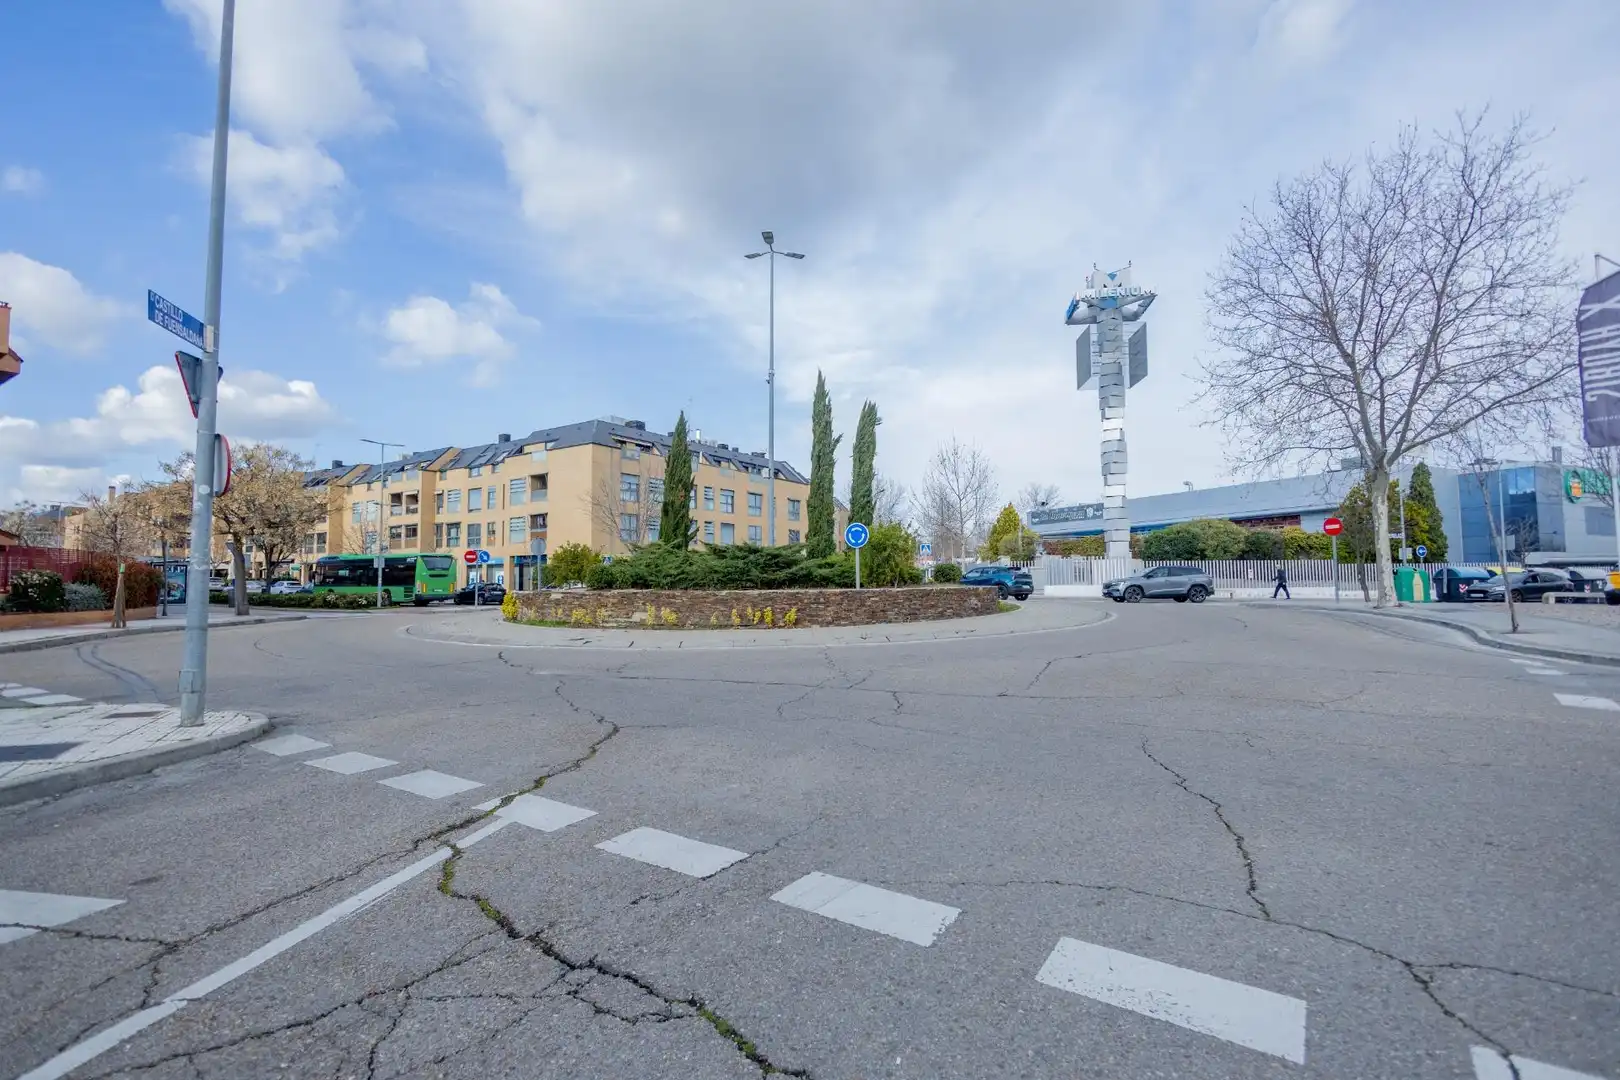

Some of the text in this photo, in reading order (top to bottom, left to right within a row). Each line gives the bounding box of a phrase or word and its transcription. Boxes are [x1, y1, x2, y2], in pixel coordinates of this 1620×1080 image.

[1081, 285, 1156, 300] MILENIUM
[155, 294, 183, 322] CASTILLO
[155, 310, 164, 326] DE
